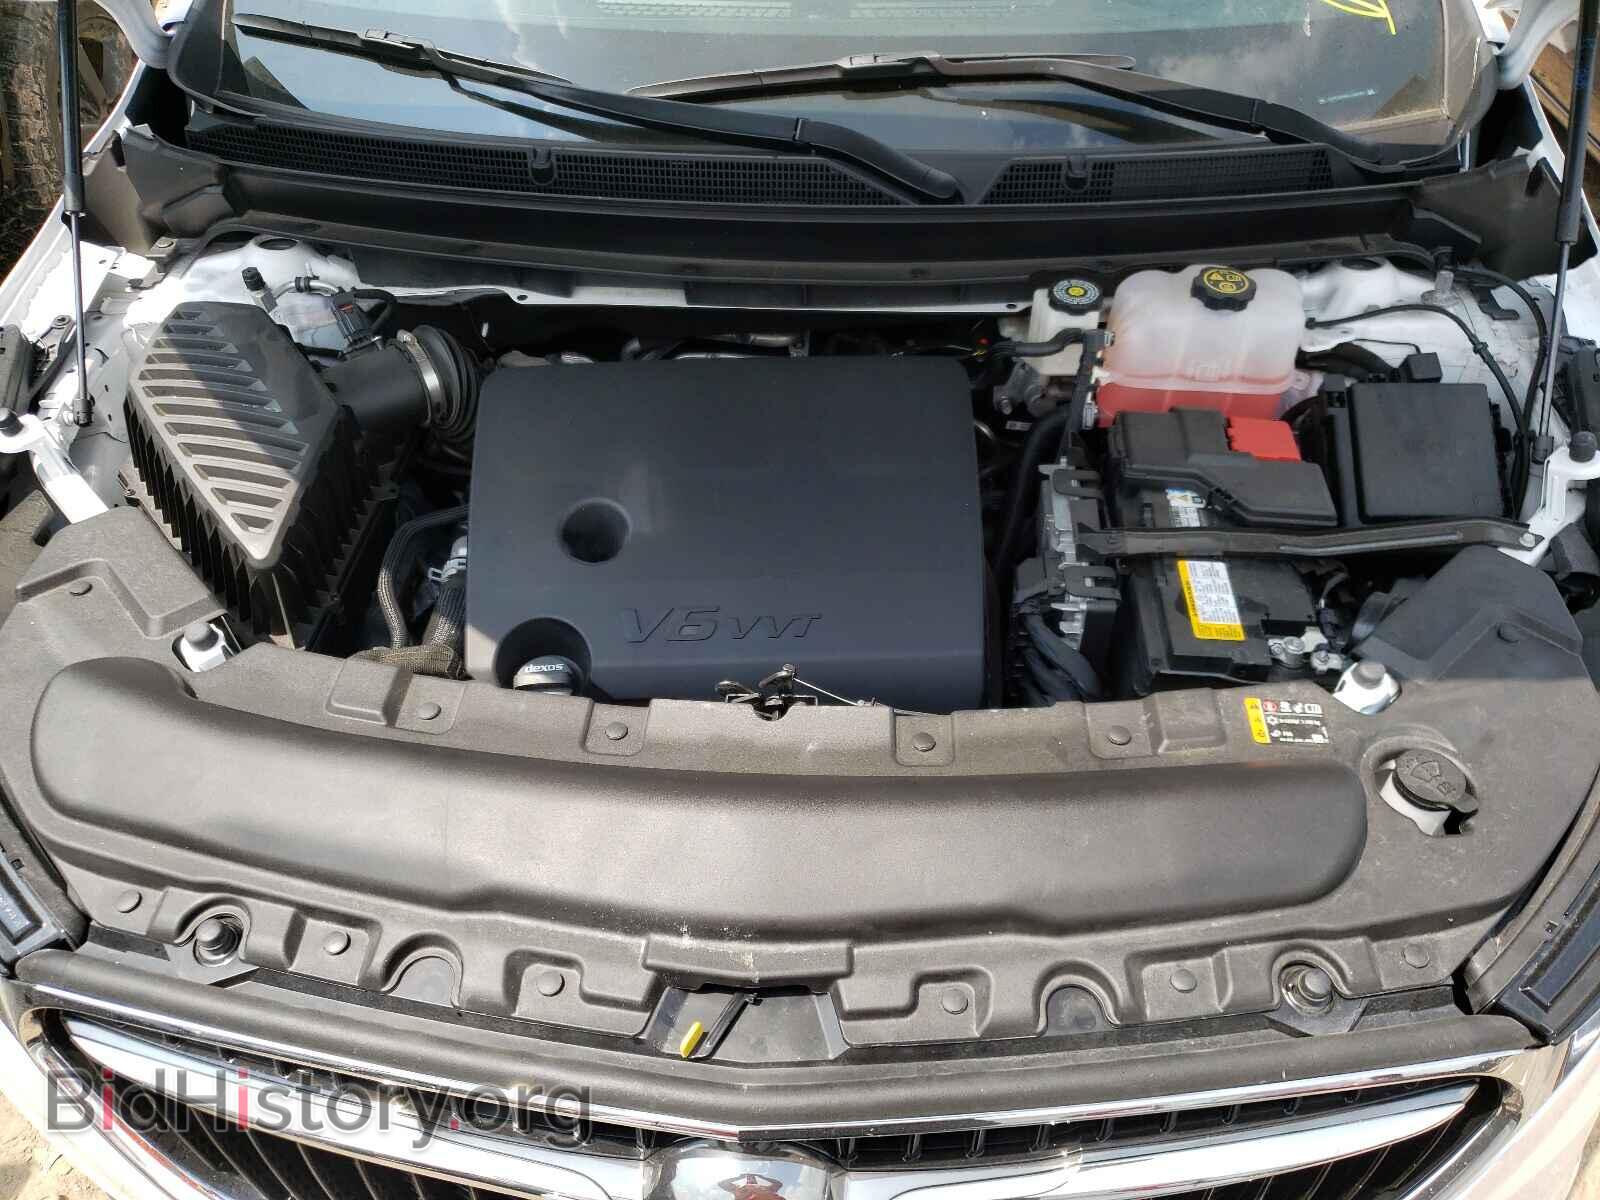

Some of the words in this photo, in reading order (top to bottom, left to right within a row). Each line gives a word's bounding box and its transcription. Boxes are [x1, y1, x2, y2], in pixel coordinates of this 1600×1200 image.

[621, 606, 721, 644] V6
[728, 613, 823, 640] VVT
[524, 663, 566, 673] dexos
